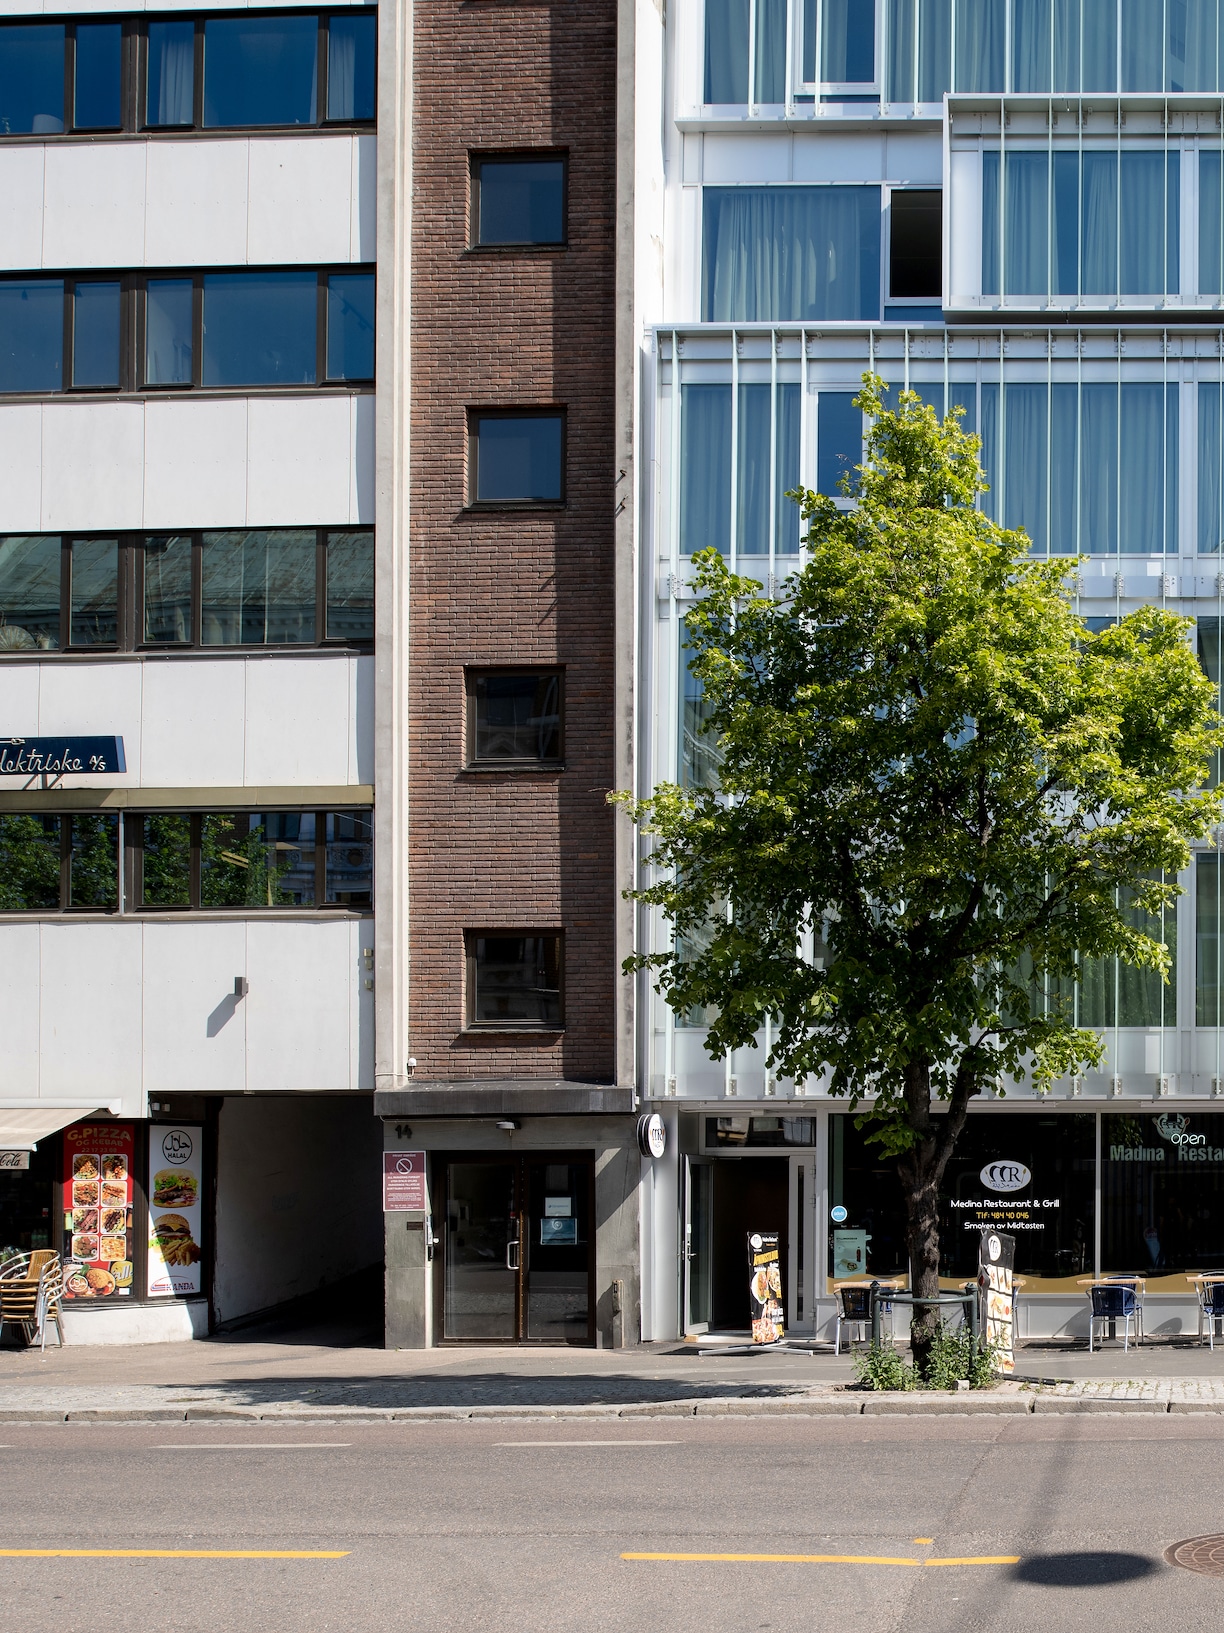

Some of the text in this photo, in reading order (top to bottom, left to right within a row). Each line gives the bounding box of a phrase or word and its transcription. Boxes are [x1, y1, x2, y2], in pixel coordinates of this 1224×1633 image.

[66, 1127, 132, 1142] G.PIZZA
[395, 1125, 412, 1139] 14
[75, 1138, 124, 1147] OG KEBAB
[1171, 1133, 1206, 1146] open
[0, 1152, 22, 1167] Cola
[1109, 1144, 1165, 1162] Madina
[950, 1199, 1060, 1208] Medina Restaurant & Grill
[976, 1211, 1030, 1219] Tlf: 484 40 046
[963, 1222, 995, 1230] Smaken
